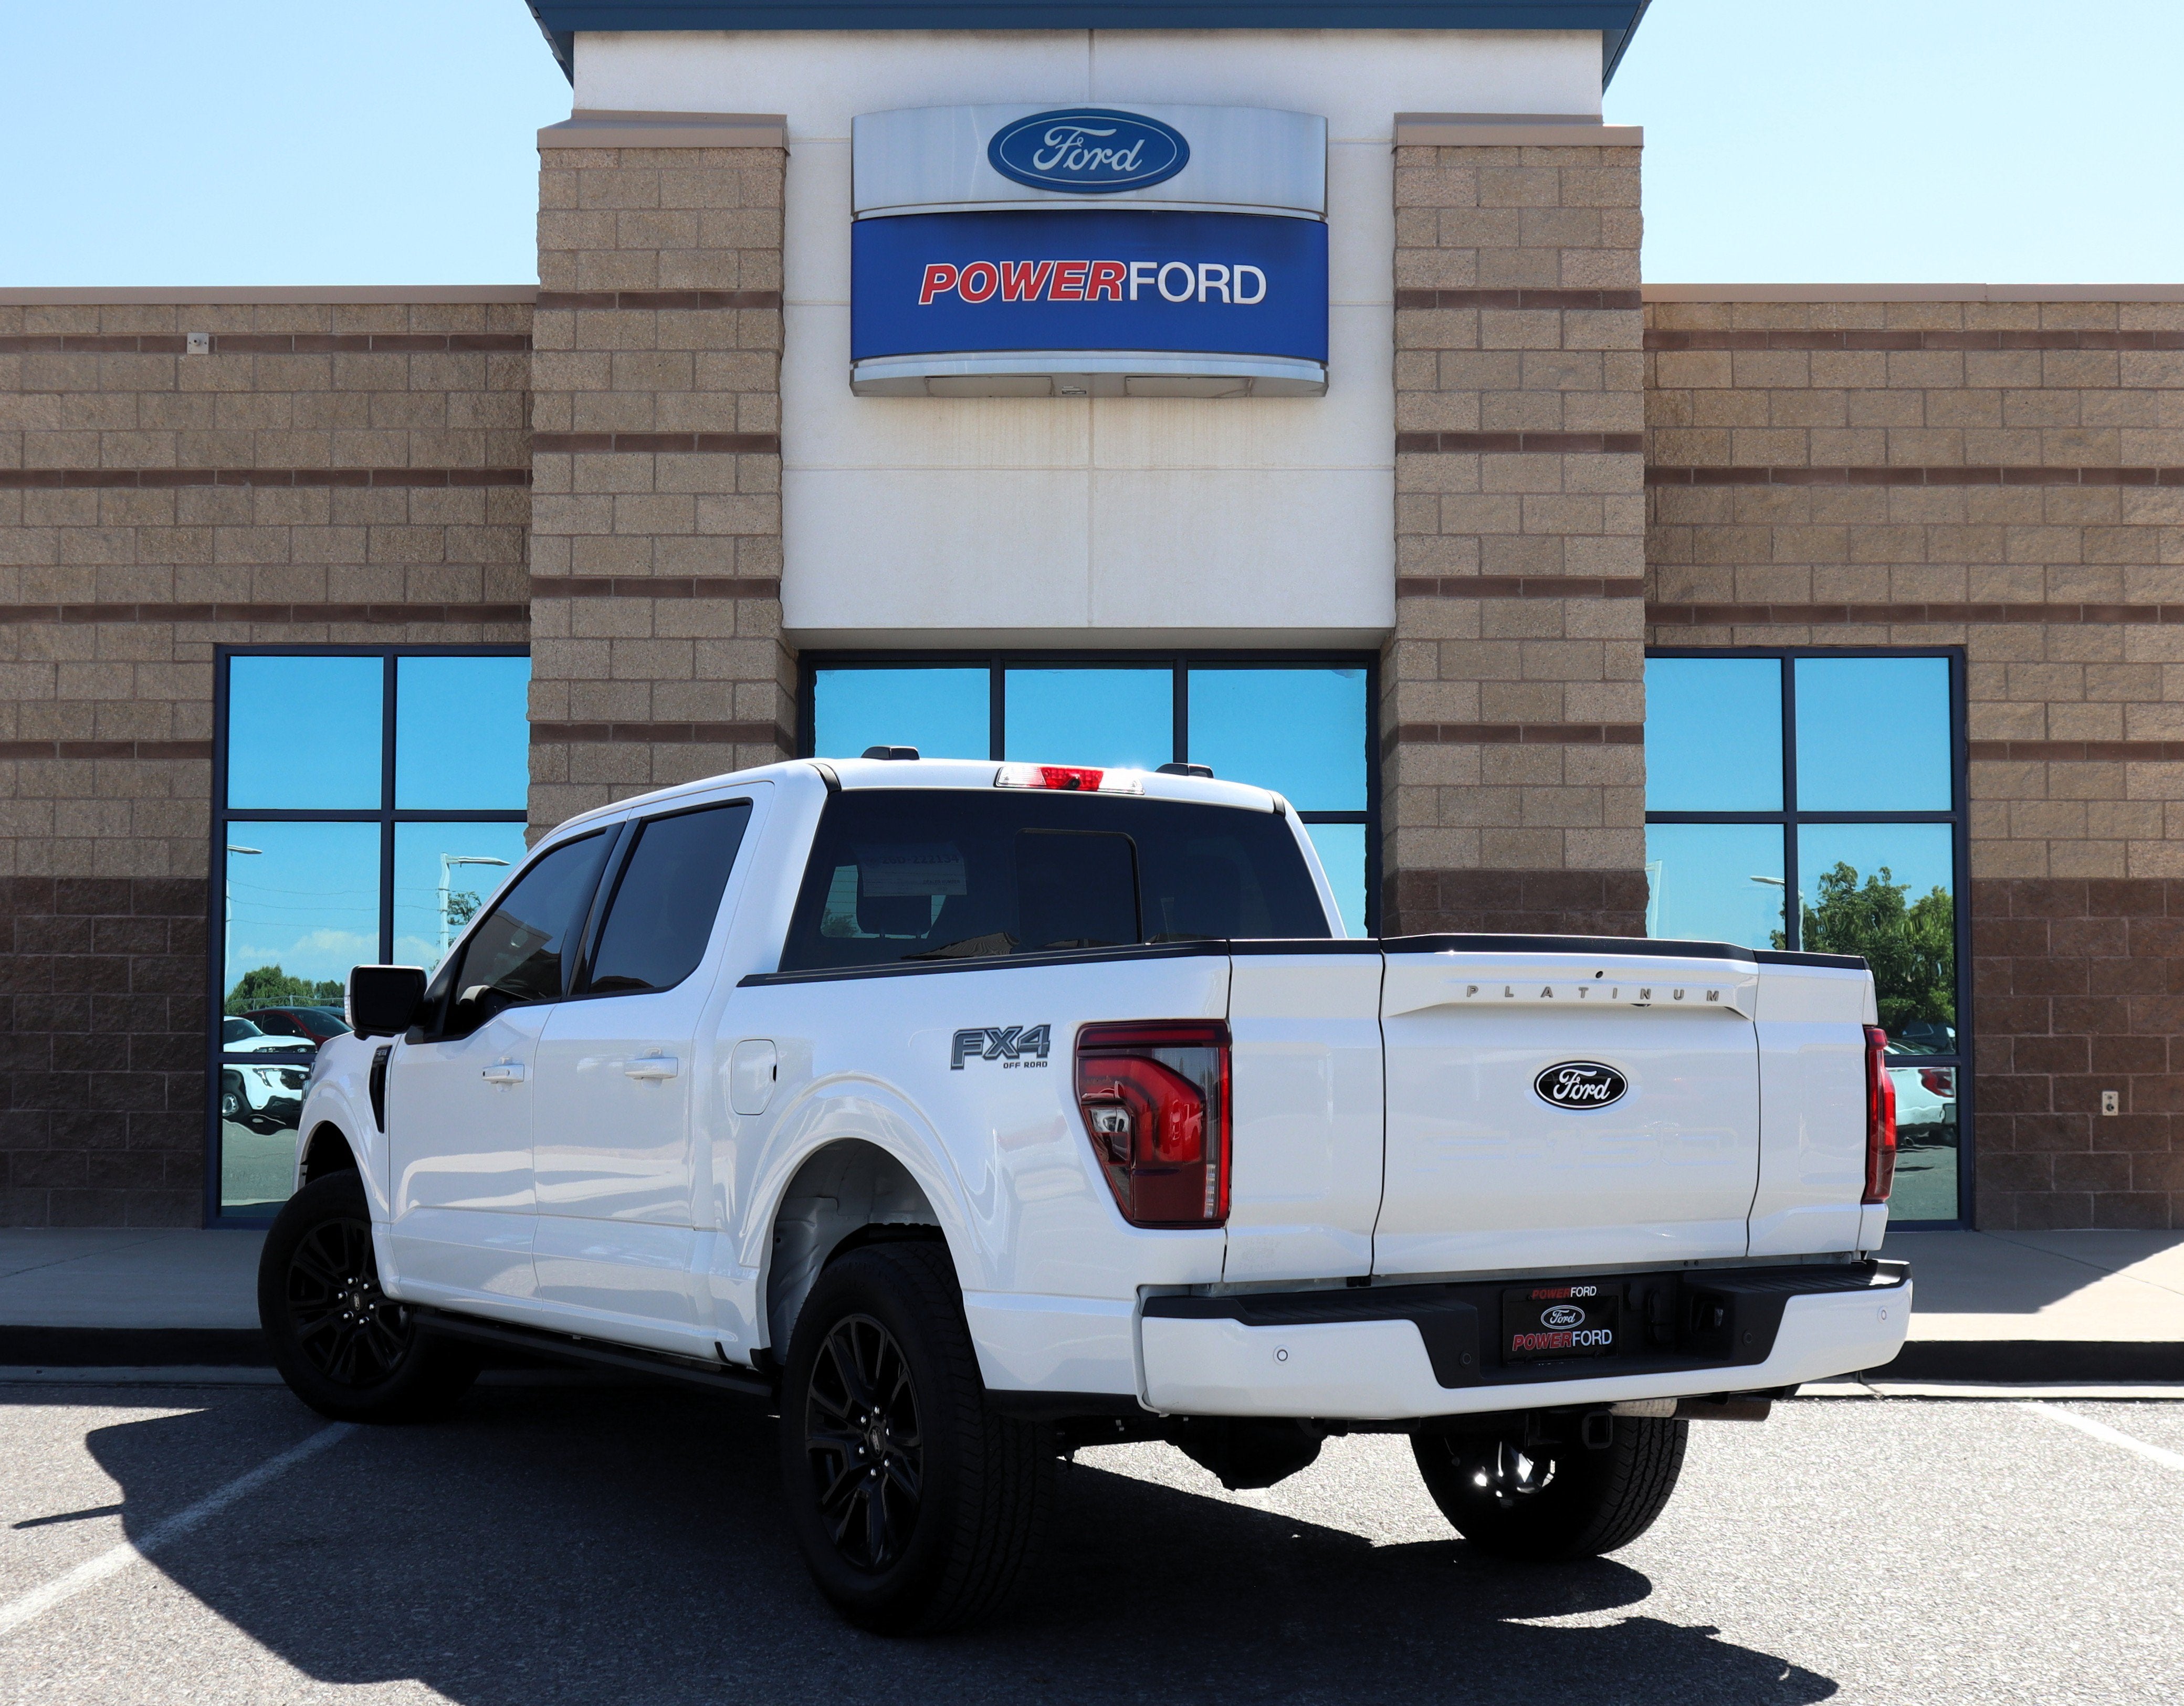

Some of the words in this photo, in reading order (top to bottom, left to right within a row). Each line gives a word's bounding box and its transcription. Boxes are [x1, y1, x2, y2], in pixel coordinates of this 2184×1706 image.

[1033, 125, 1145, 172] Ford
[918, 260, 1267, 305] POWERFORD
[1466, 985, 1719, 1002] PLATINUM
[950, 1024, 1051, 1070] FX4
[1552, 1068, 1612, 1100] Ford
[1531, 1286, 1597, 1300] POWERFORD
[1549, 1310, 1577, 1324] Ford
[1512, 1329, 1612, 1351] POWERFORD
